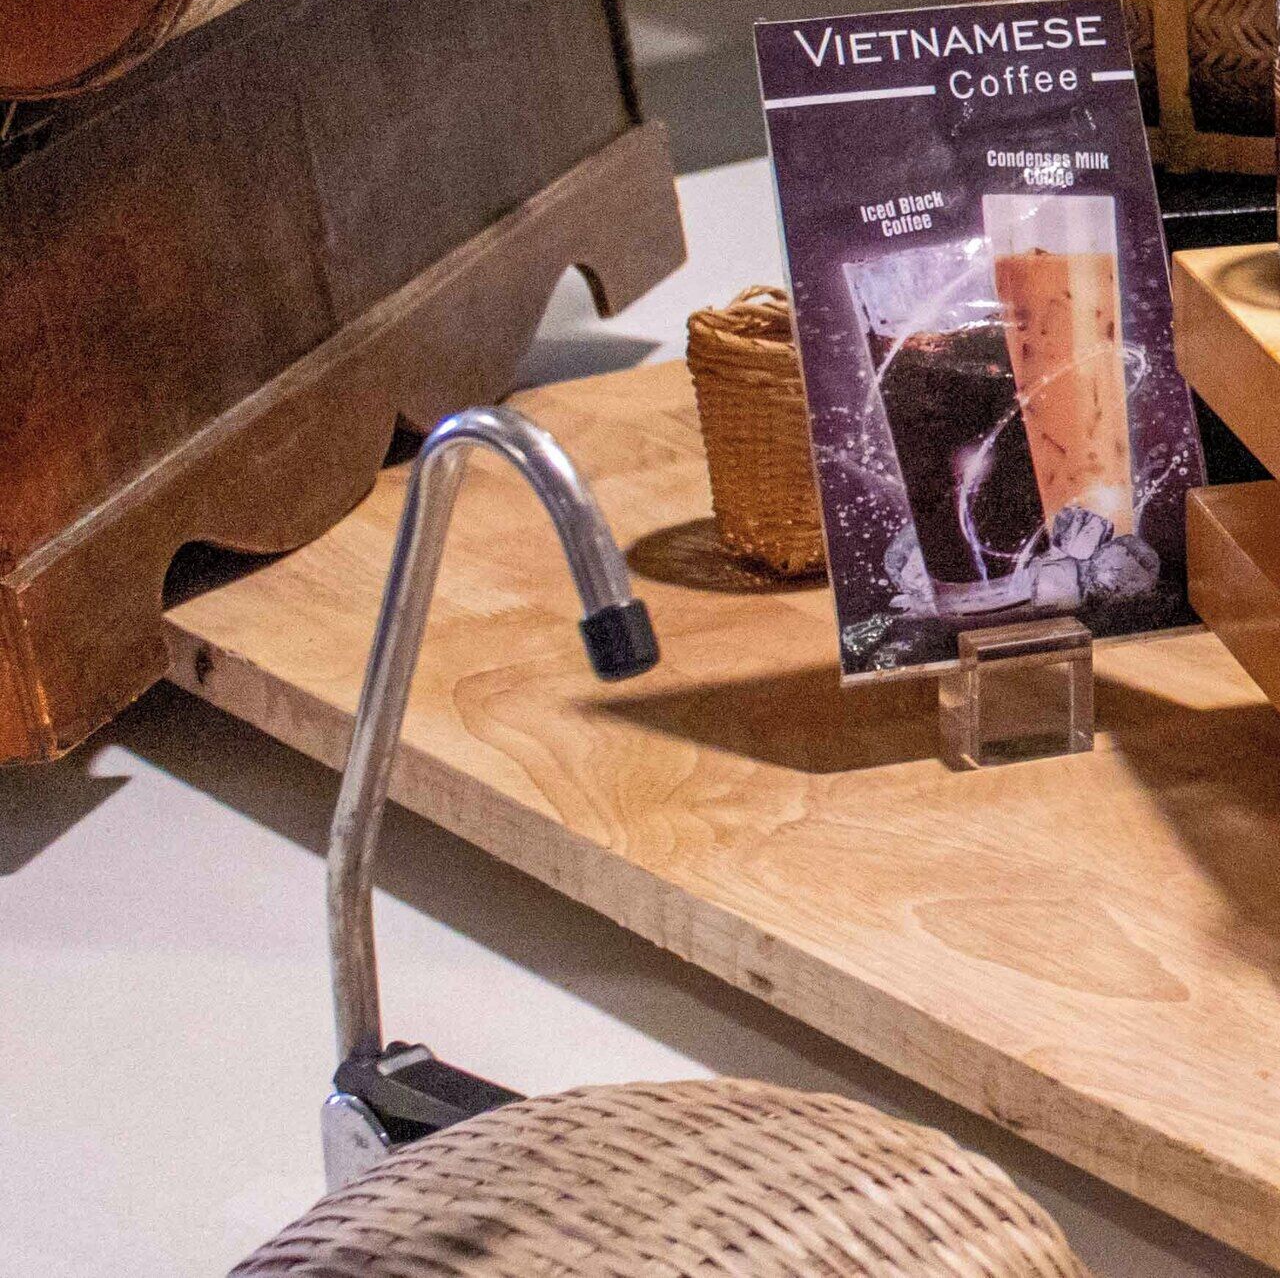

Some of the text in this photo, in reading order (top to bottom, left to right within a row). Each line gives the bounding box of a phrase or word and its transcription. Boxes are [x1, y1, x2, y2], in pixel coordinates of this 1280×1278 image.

[793, 15, 1106, 68] VIETNAMESE
[949, 64, 1078, 100] Coffee
[1075, 151, 1110, 170] Milk
[860, 191, 945, 224] Iced Black
[881, 212, 933, 238] Coffee
